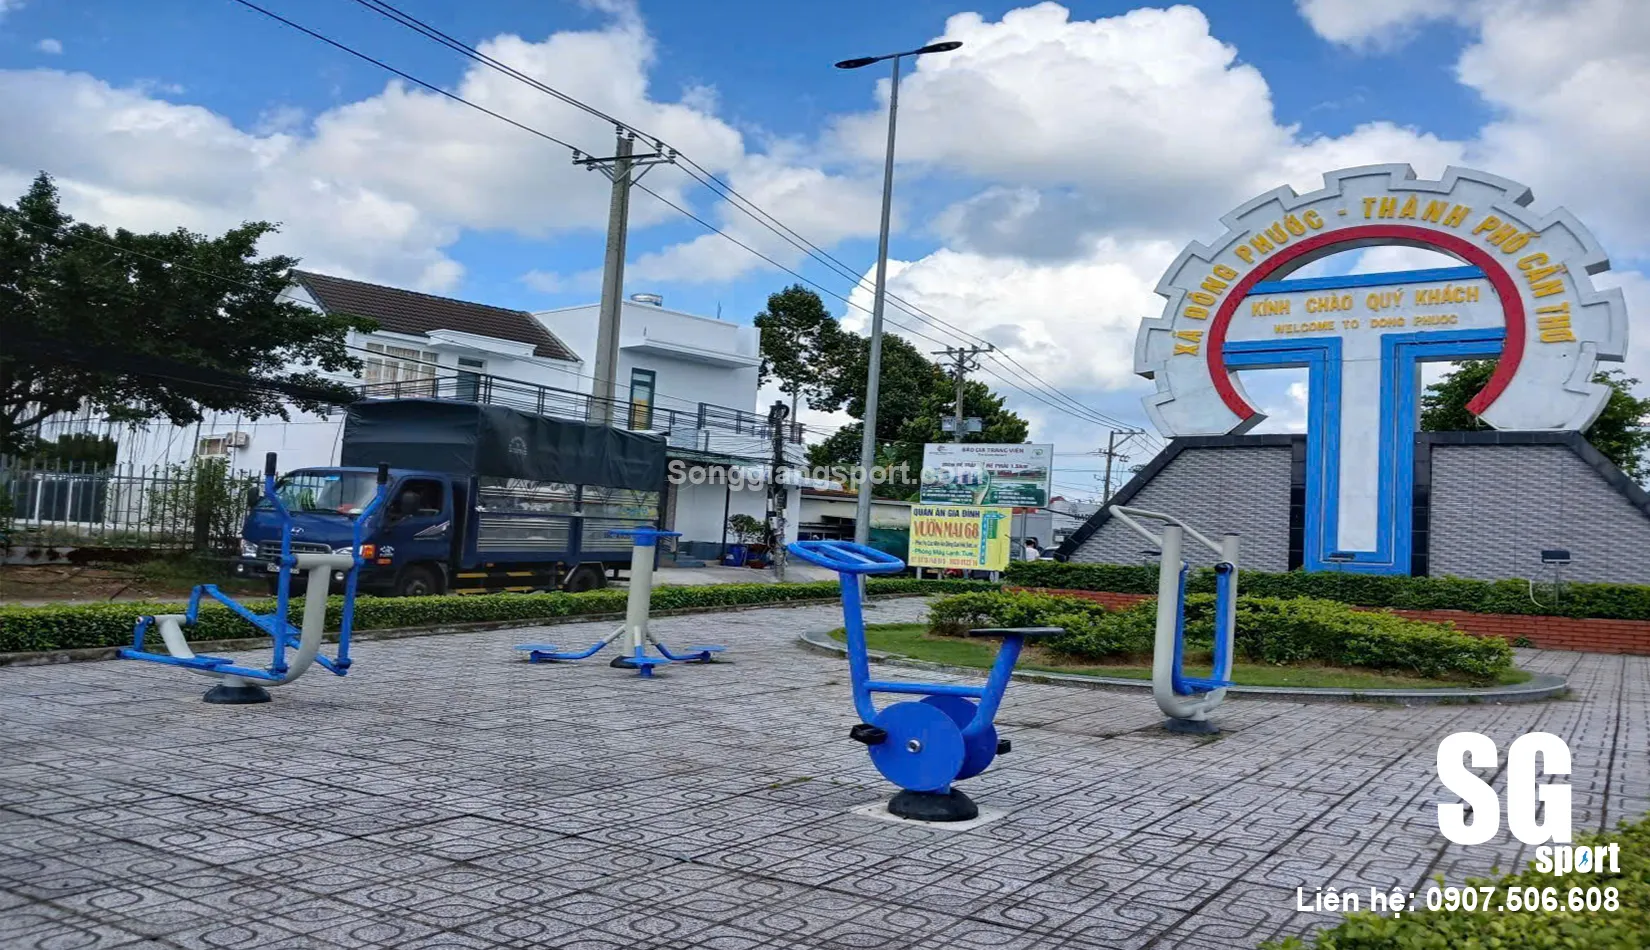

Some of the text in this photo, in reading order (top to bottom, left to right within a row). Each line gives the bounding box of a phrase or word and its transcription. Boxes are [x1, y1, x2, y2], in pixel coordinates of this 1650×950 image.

[1363, 195, 1473, 229] THÀNH
[1235, 209, 1324, 264] PHƯỚC
[1472, 215, 1541, 255] PHỐ
[1517, 252, 1570, 299] CẦN
[1251, 283, 1479, 317] KÍNH CHÀO QUÝ KHÁCH
[1274, 314, 1458, 334] WELCOME TO DONG PHUOC
[1535, 301, 1577, 344] THƠ
[913, 508, 980, 517] QUÁN ĂN GIA ĐÌNH
[944, 521, 963, 538] MAI
[965, 522, 979, 539] 68
